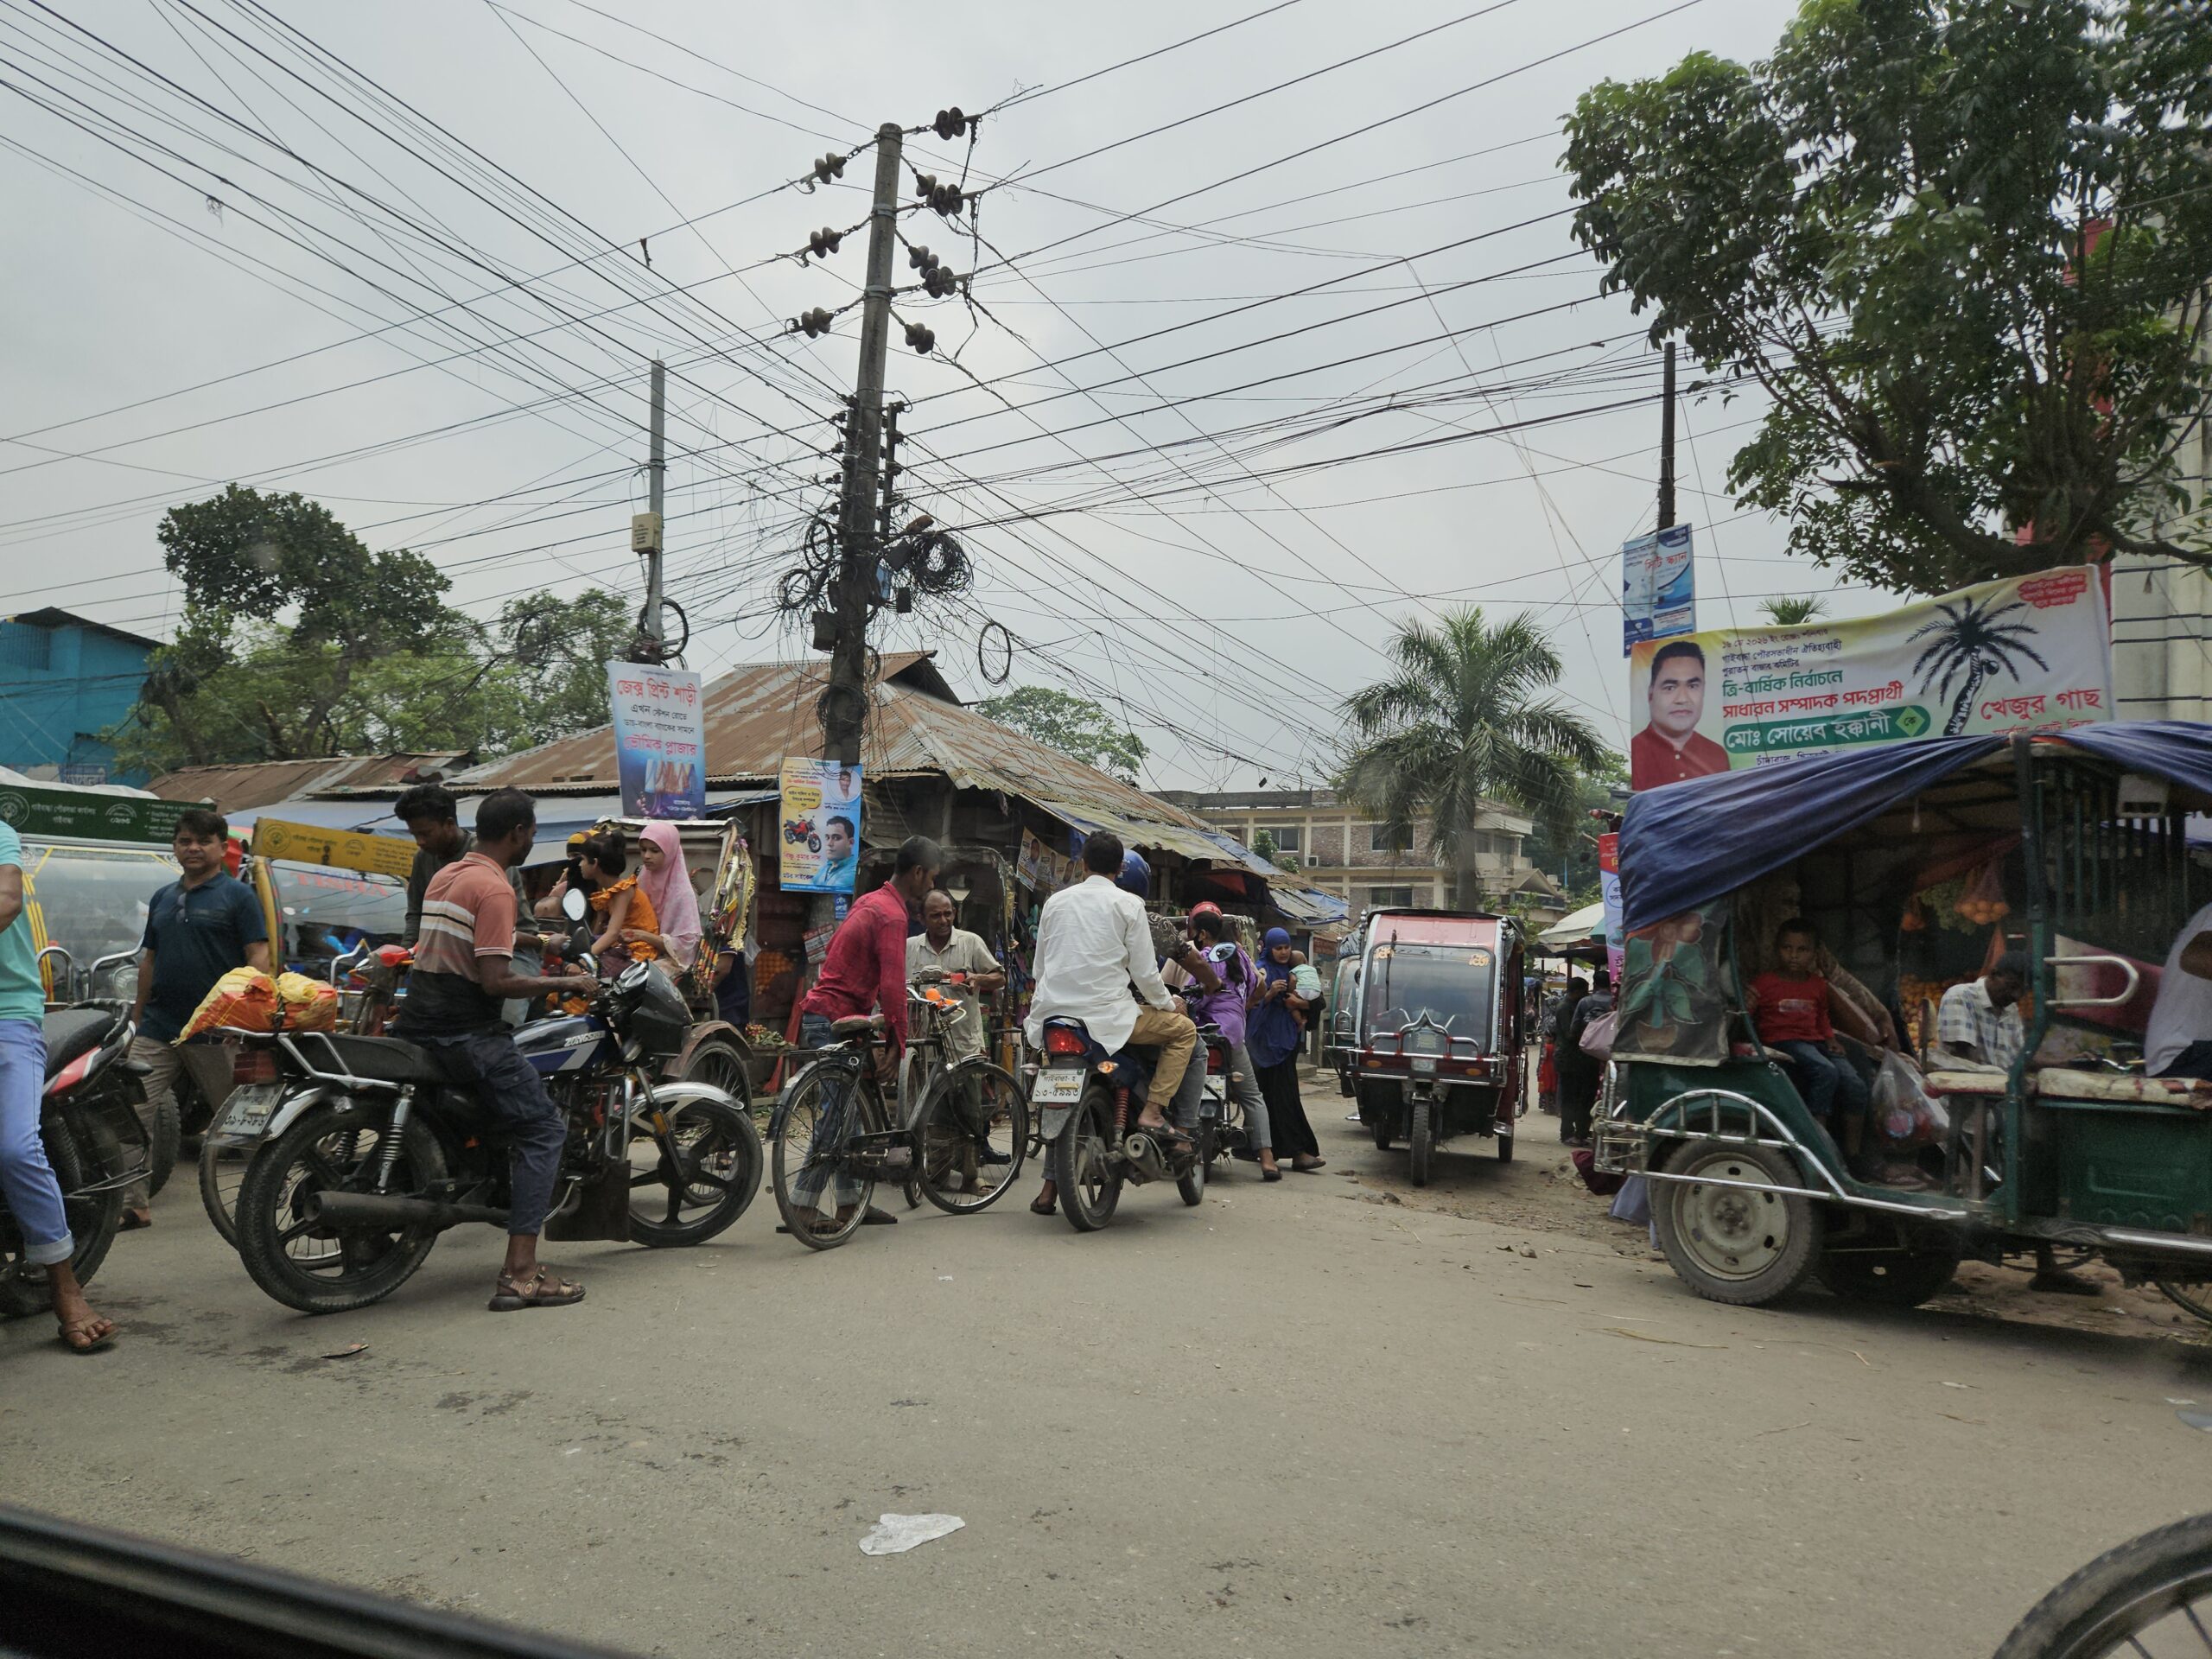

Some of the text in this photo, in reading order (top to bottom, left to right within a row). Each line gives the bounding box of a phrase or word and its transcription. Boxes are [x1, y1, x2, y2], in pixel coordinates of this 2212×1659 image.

[1723, 669, 1843, 697] ত্রি-বার্ষিক নির্বাচনে
[1778, 693, 1839, 713] সম্পাদক
[1842, 679, 1904, 706] পদপ্রার্থী
[1980, 689, 2102, 721] খেজুর গাছ
[1726, 728, 1761, 748] মোঃ
[1766, 721, 1827, 745] সোয়েব
[1833, 709, 1891, 740] হক্কানী
